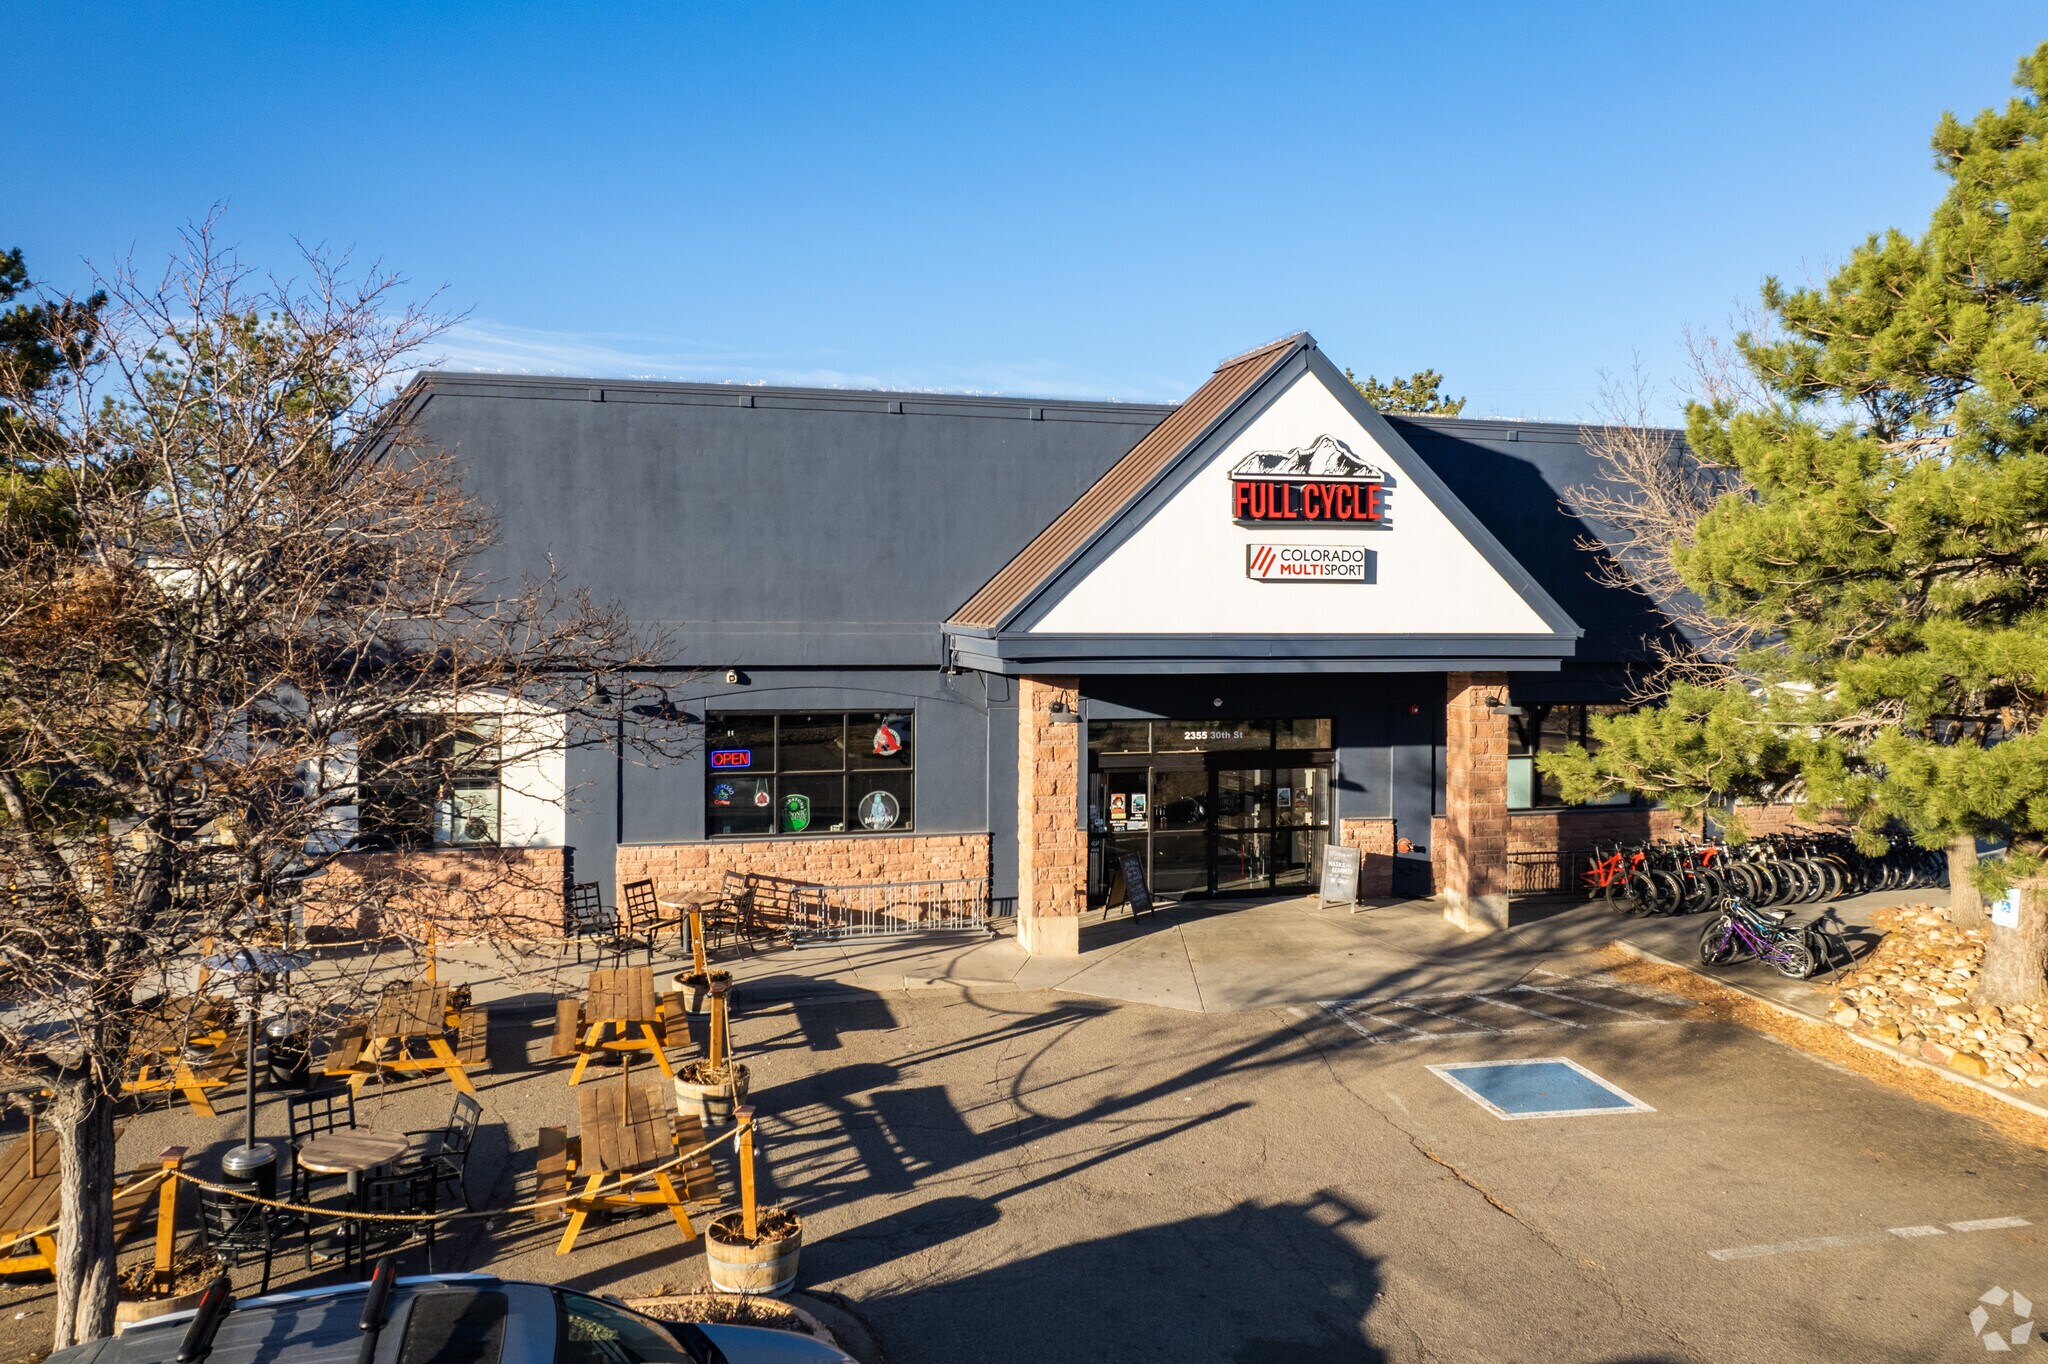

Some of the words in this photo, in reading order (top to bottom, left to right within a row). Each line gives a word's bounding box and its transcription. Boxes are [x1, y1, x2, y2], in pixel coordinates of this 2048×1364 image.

[1235, 482, 1297, 518] FULL
[1303, 483, 1382, 519] CYCLE
[1280, 548, 1364, 562] COLORADO
[1280, 564, 1364, 576] MULTISPORT
[1184, 731, 1208, 740] 2355
[1210, 731, 1231, 739] 30th
[1233, 731, 1244, 739] St
[713, 752, 749, 766] OPEN
